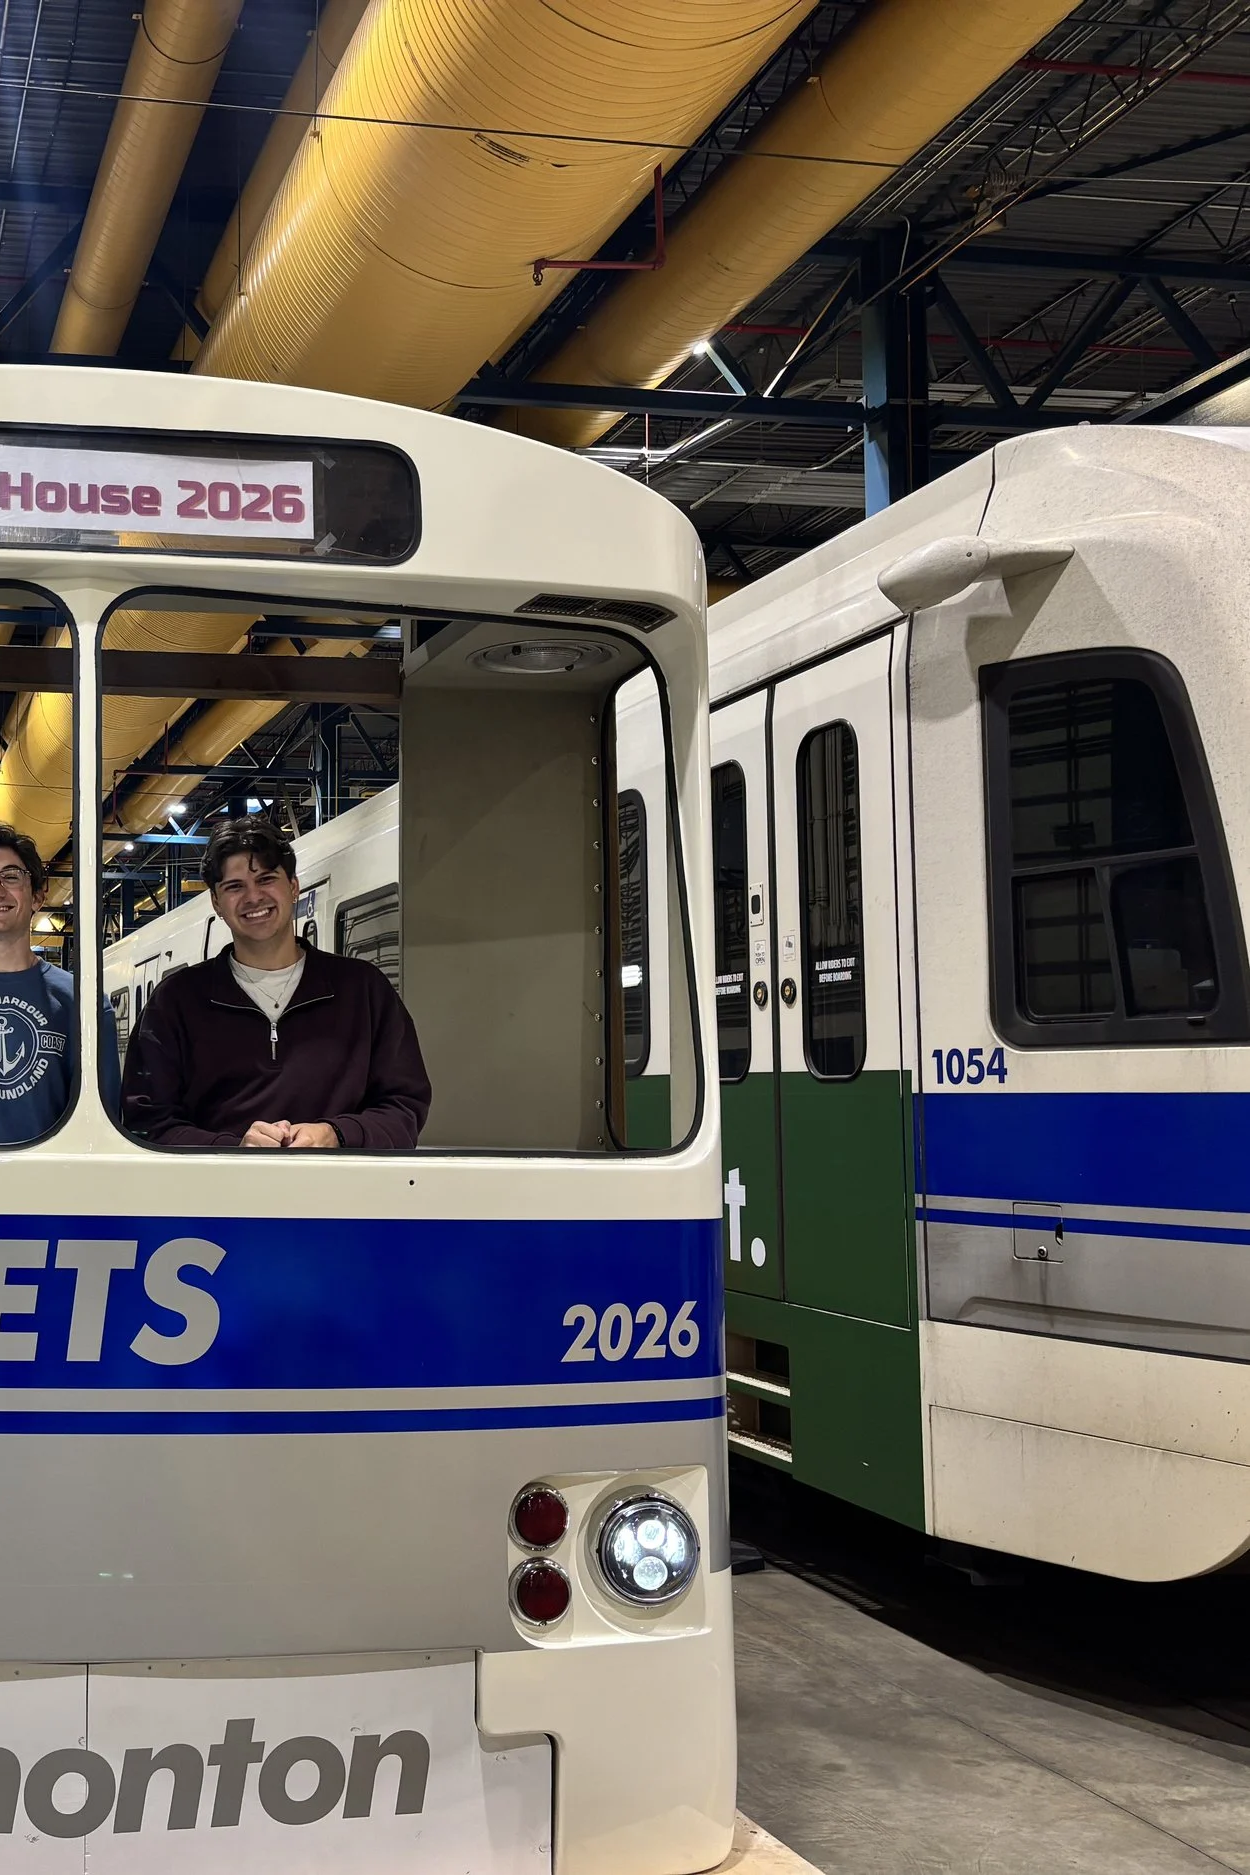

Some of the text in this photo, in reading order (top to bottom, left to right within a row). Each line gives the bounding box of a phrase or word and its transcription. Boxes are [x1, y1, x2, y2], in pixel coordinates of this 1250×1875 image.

[176, 479, 307, 525] 2026
[815, 957, 855, 971] ALLOW RIDERS TO EXIT
[819, 970, 852, 983] BEFORE BOARDING
[40, 1034, 66, 1052] COAST
[932, 1048, 1008, 1085] 1054
[560, 1301, 699, 1363] 2026
